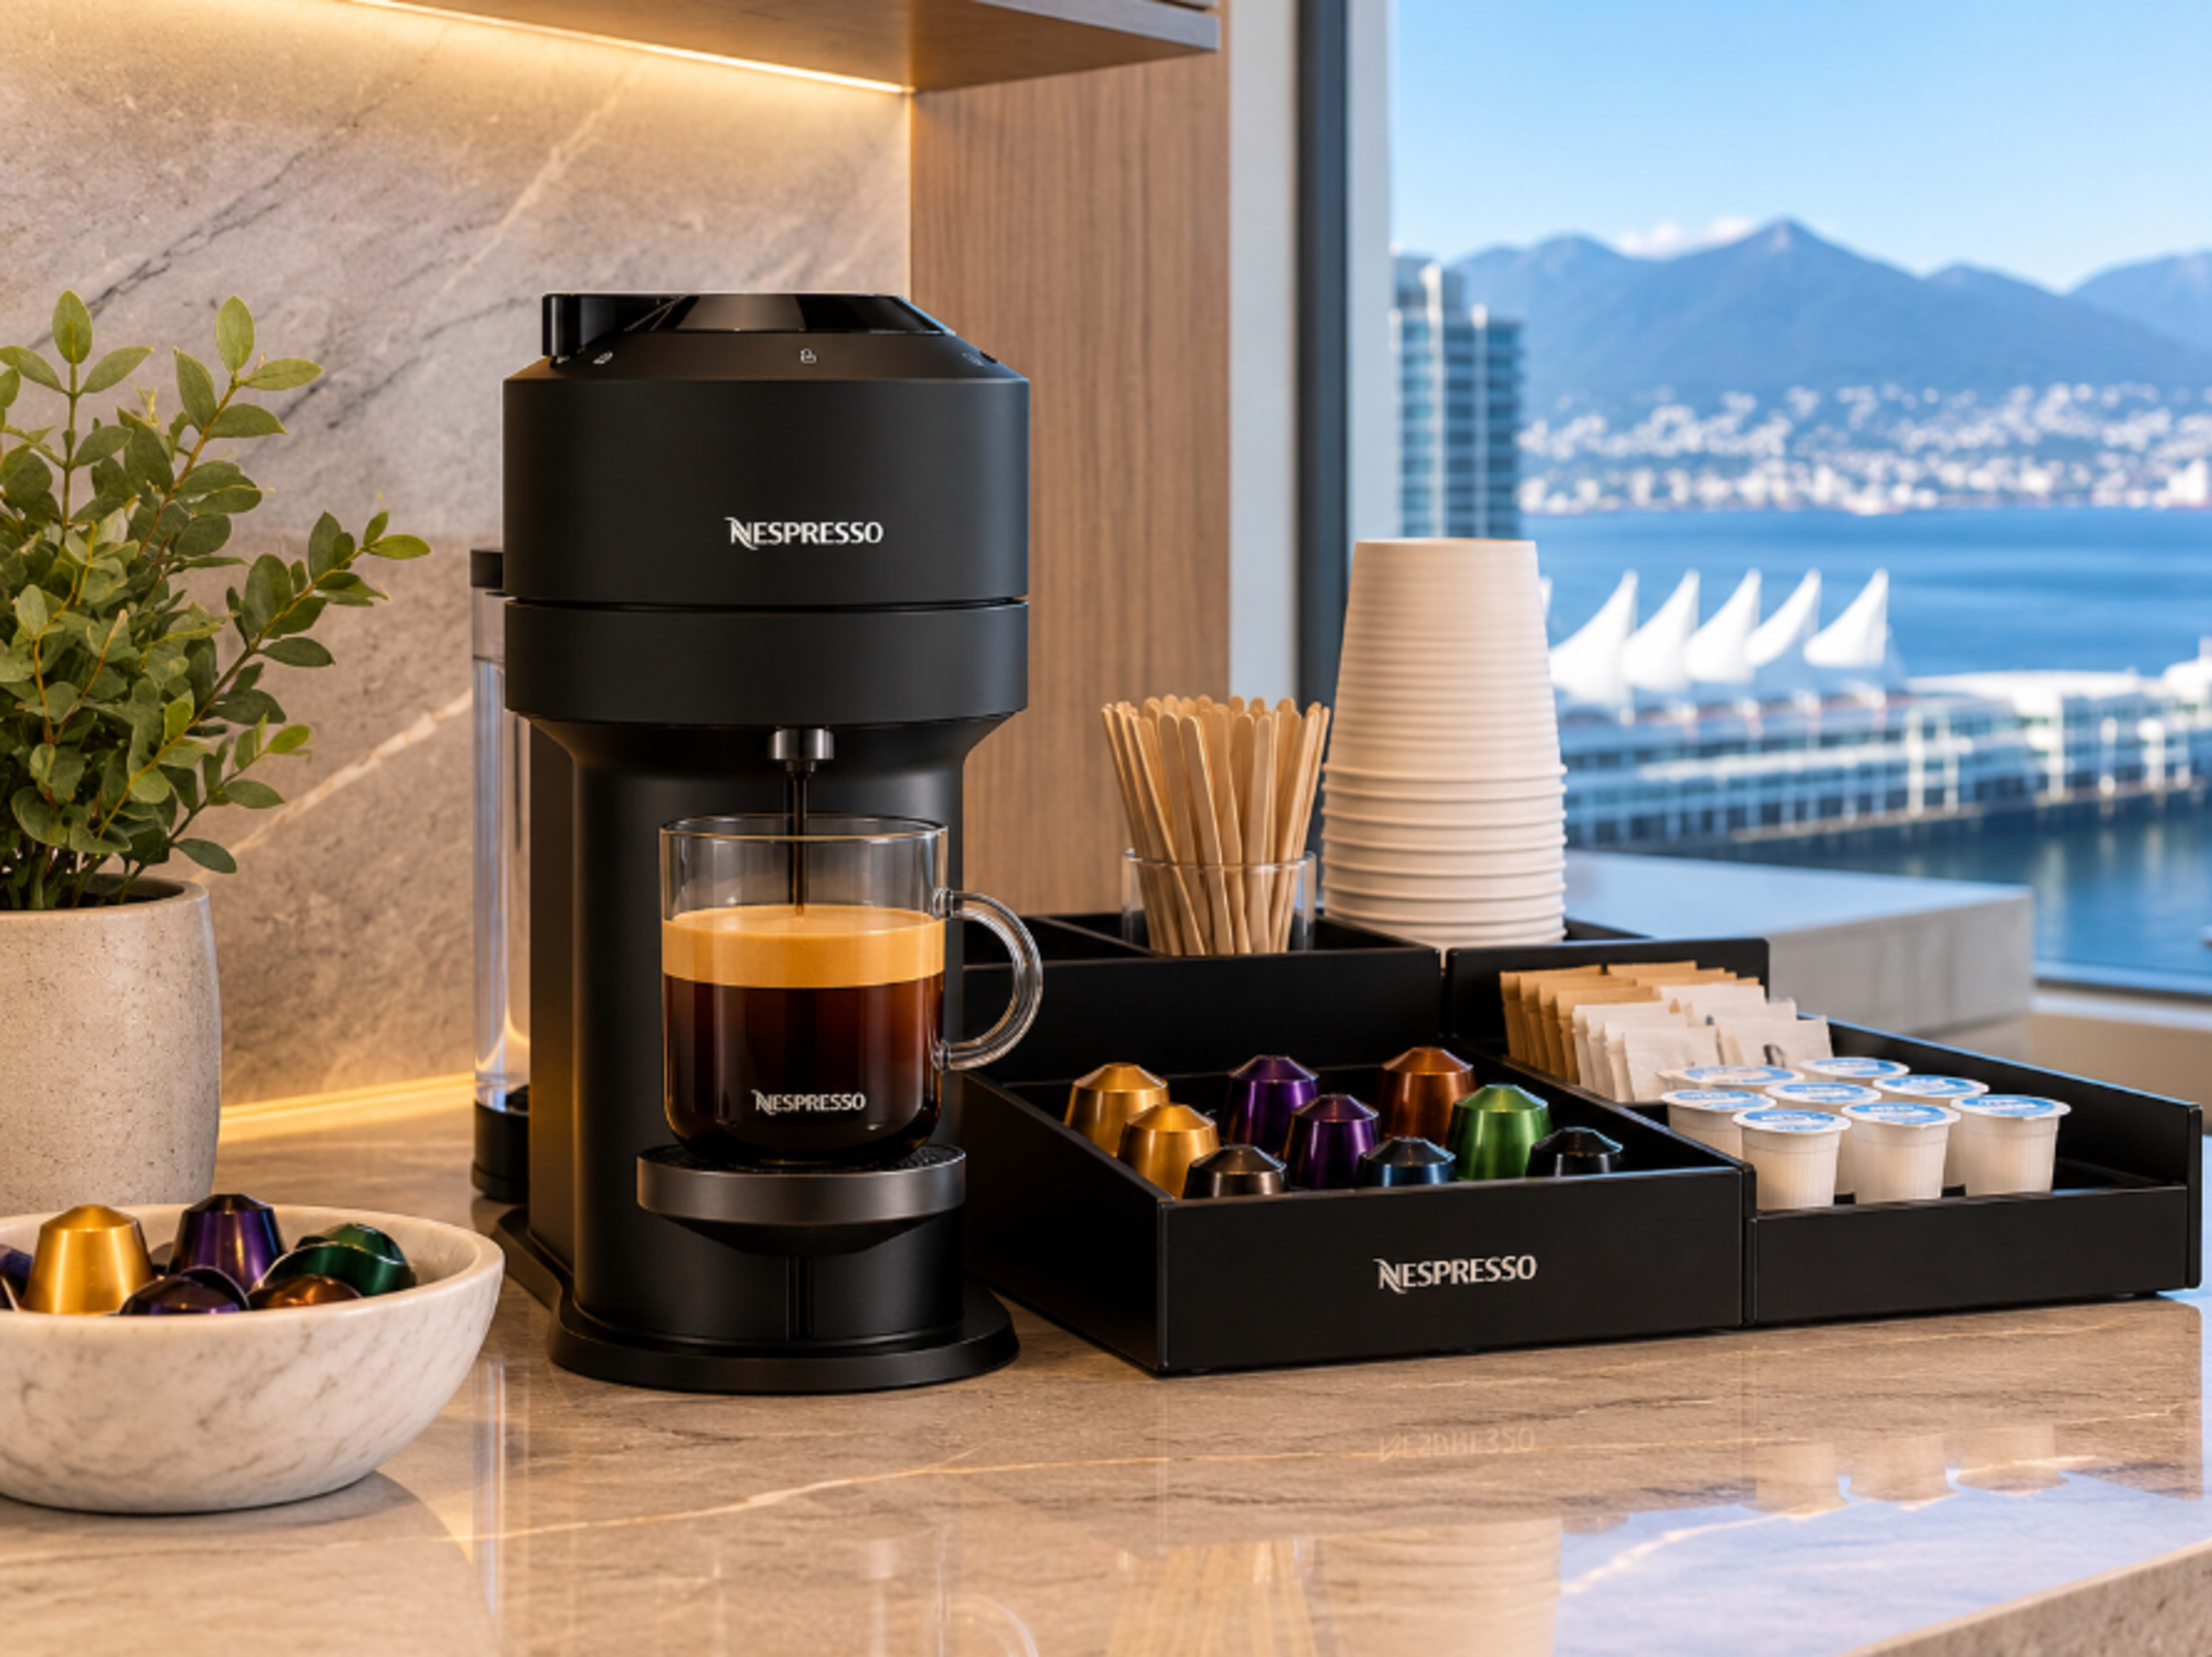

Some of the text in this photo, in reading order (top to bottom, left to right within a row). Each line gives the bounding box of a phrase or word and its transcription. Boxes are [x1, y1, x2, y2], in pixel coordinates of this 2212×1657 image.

[725, 517, 884, 551] NESPRESSO
[751, 1089, 866, 1116] NESPRESSO
[1374, 1254, 1537, 1294] NESPRESSO
